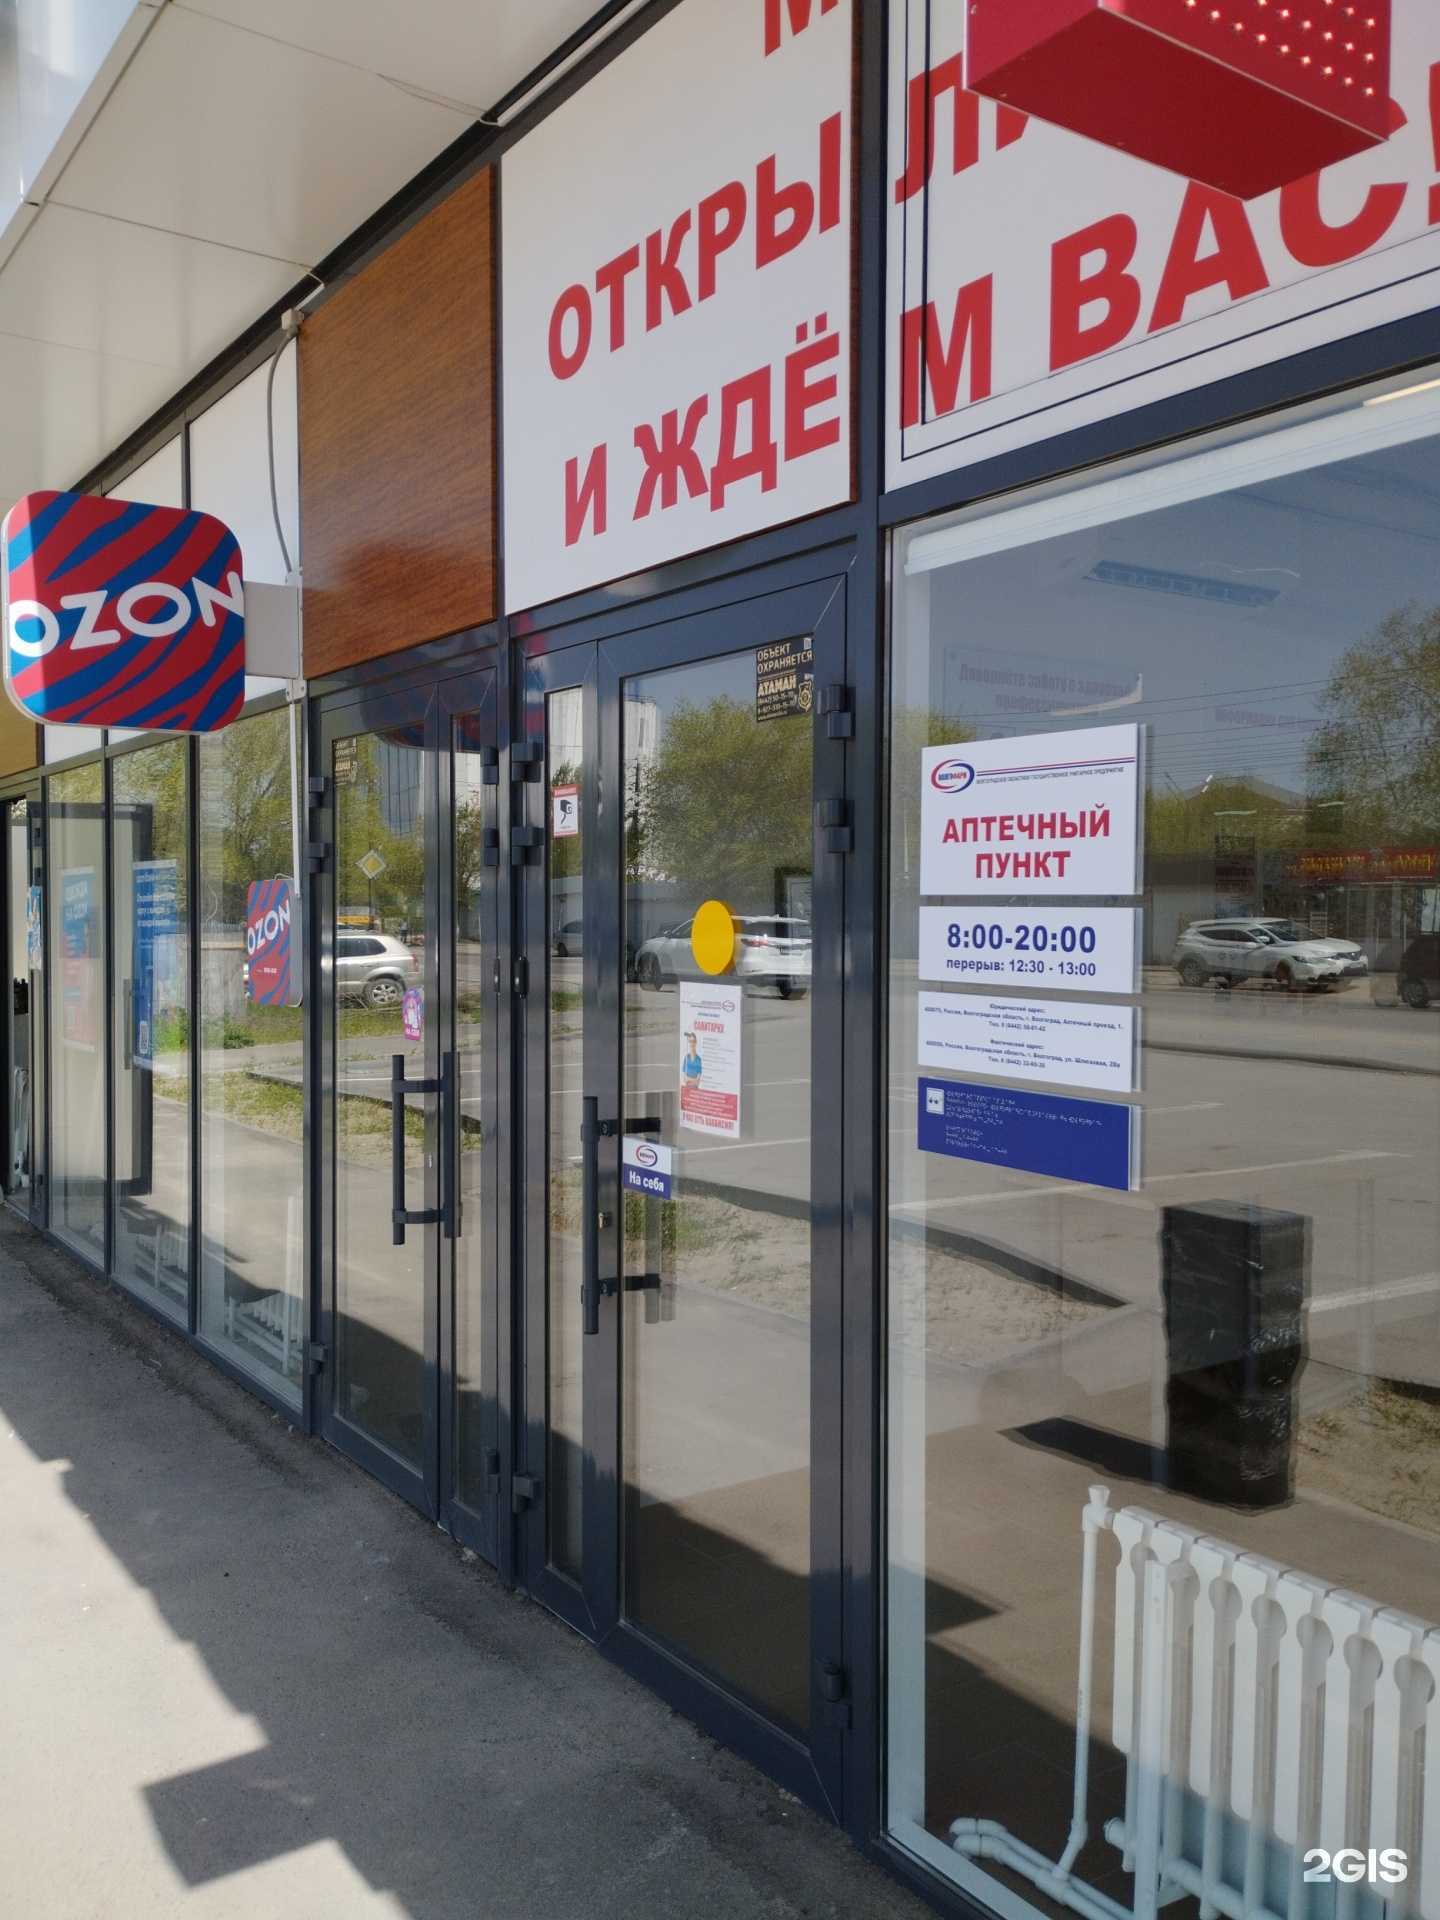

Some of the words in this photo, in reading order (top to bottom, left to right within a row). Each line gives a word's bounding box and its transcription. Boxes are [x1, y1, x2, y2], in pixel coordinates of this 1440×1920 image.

[547, 111, 842, 380] ОТКРЫ
[900, 272, 993, 430] М
[565, 443, 606, 546] И
[632, 314, 842, 520] ЖДЁ
[9, 571, 244, 657] OZON
[757, 643, 791, 661] ОБЪЕКТ
[757, 650, 813, 674] ОХРАНЯЕТСЯ
[758, 674, 797, 697] АТАМАН
[942, 803, 1110, 843] АПТЕЧНЫЙ
[976, 851, 1070, 879] ПУНКТ
[248, 899, 290, 955] OZON
[947, 923, 1096, 953] 8:00-20:00
[946, 959, 1004, 974] перерыв:
[1009, 960, 1045, 974] 12:30
[1058, 962, 1096, 976] 13:00
[629, 1170, 641, 1185] На
[643, 1177, 664, 1192] себя
